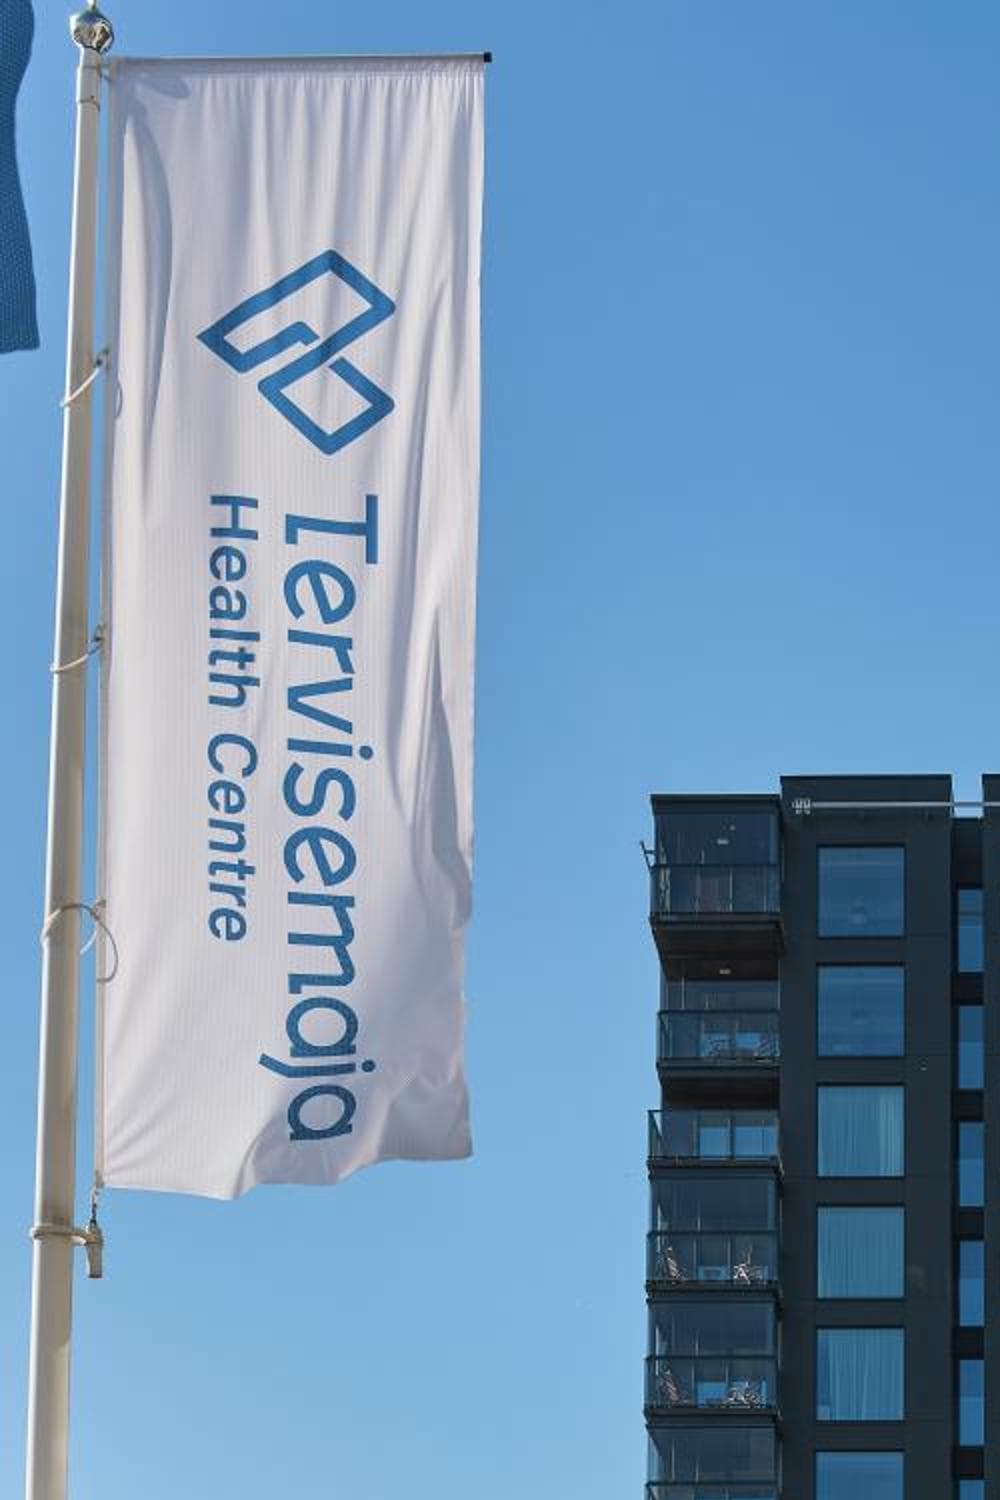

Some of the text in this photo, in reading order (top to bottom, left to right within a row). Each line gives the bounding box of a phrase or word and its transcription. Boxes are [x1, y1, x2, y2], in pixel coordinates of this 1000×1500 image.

[207, 496, 259, 943] Health Centre
[260, 496, 379, 1142] Tervisemaja
